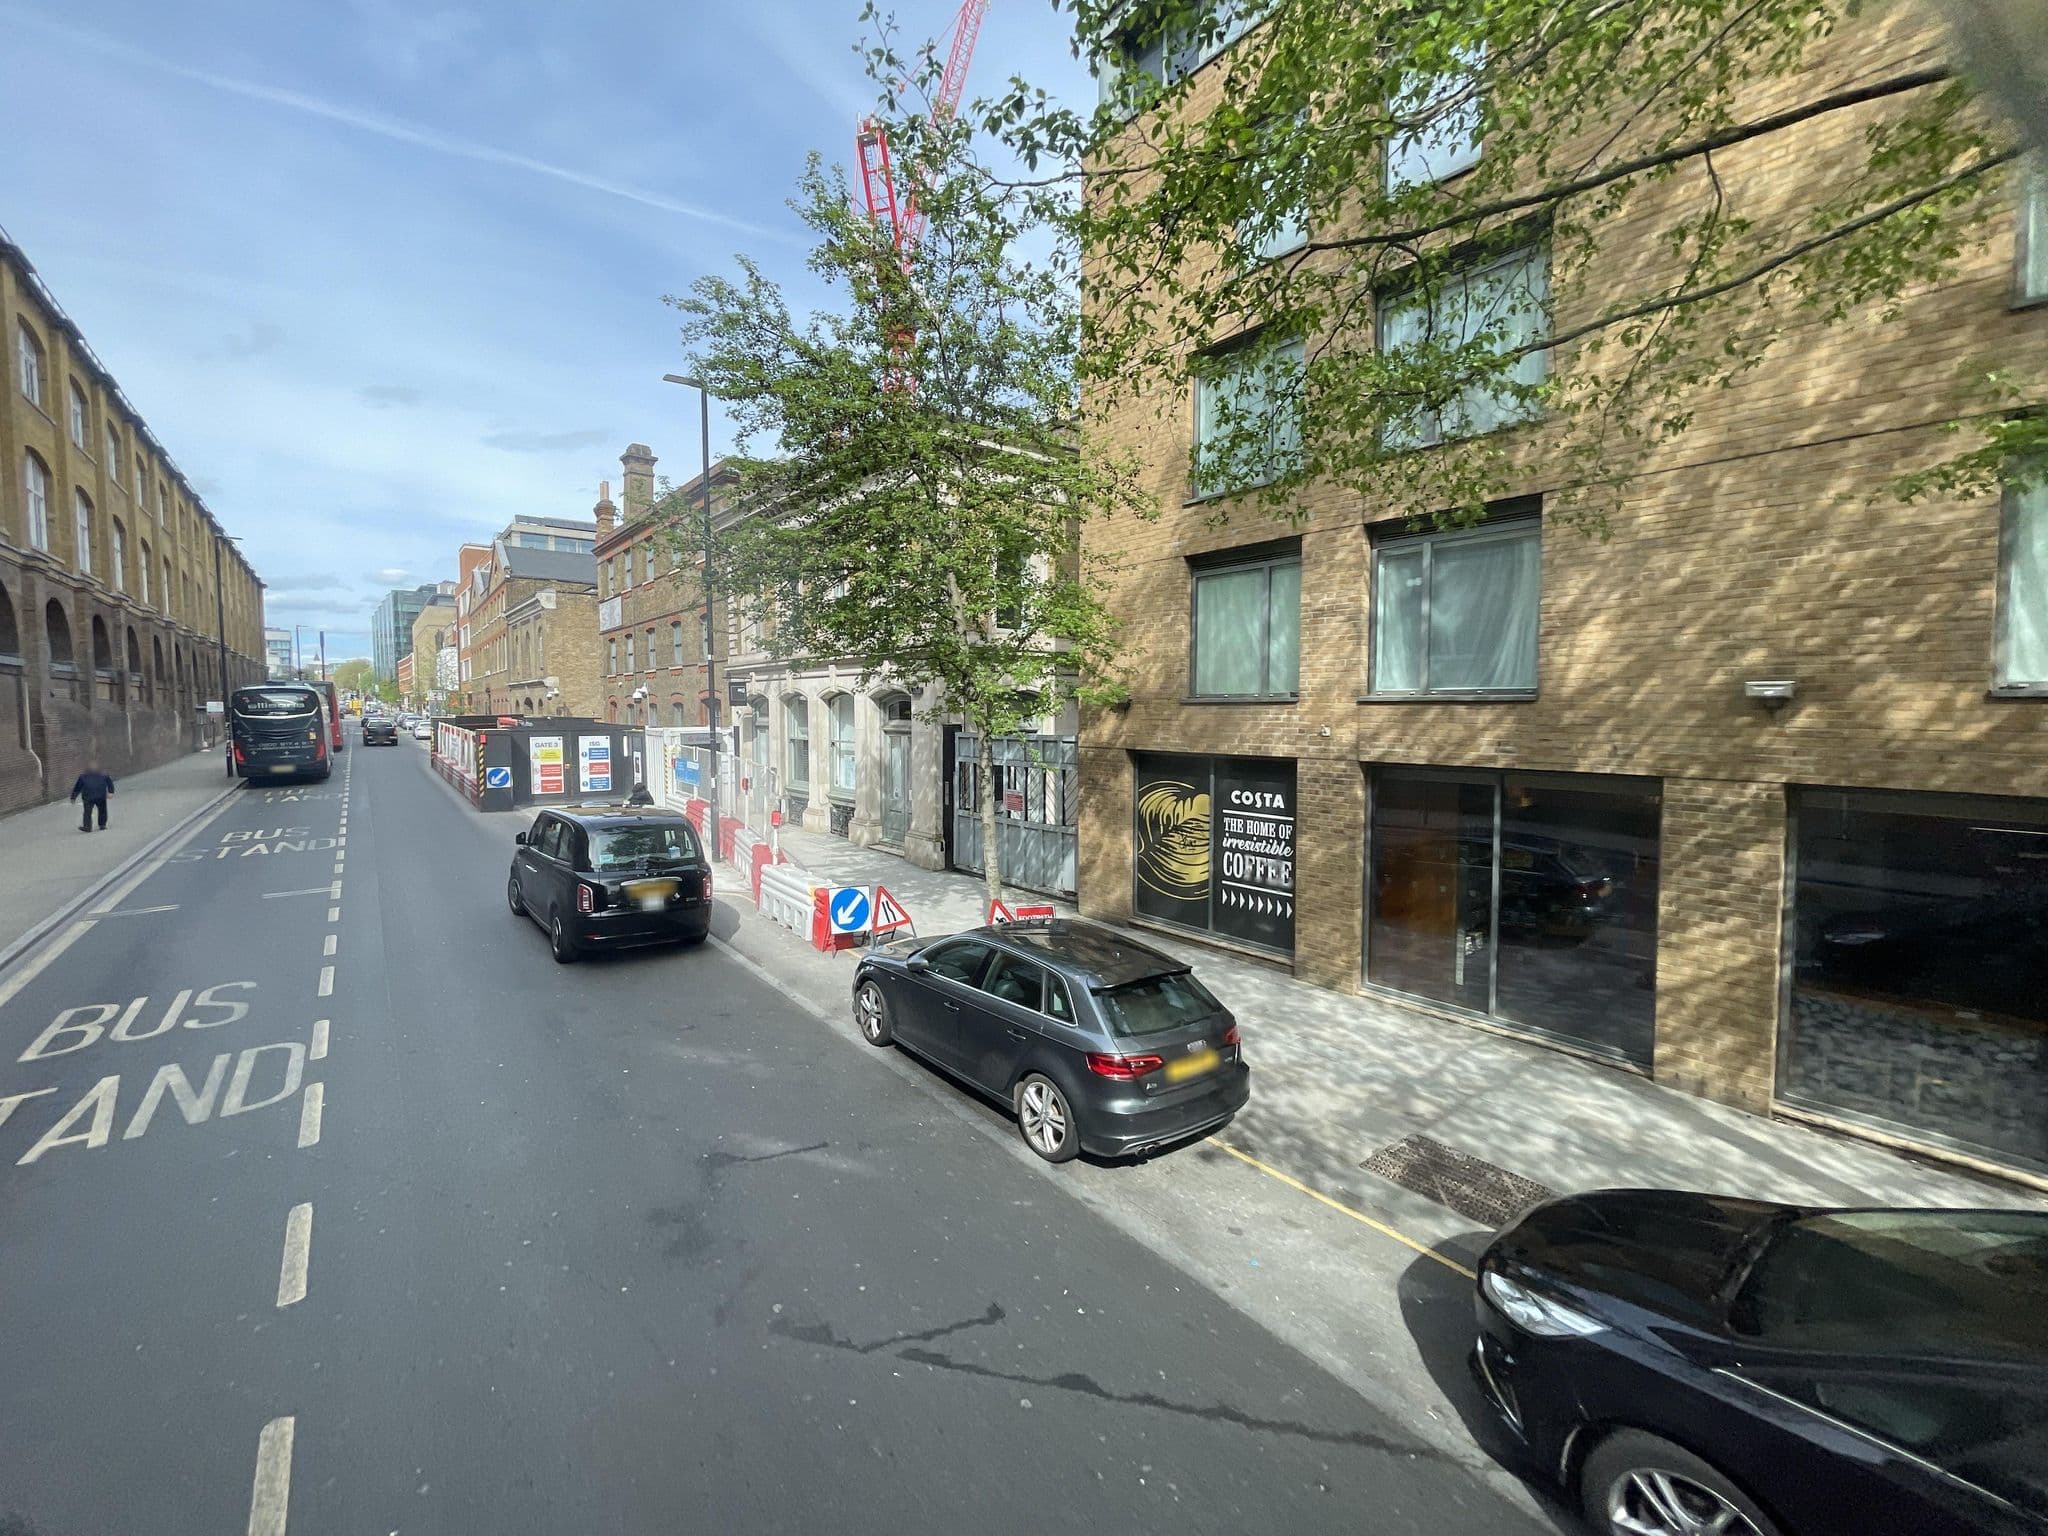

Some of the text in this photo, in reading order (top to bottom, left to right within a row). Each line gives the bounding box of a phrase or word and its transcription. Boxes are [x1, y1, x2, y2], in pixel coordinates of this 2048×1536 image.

[1230, 790, 1285, 809] COSTA
[220, 827, 311, 843] BUS
[1223, 817, 1293, 840] THE HOME OF
[1222, 832, 1294, 857] irresistible
[1223, 851, 1293, 887] COFFEE
[16, 981, 257, 1063] BUS
